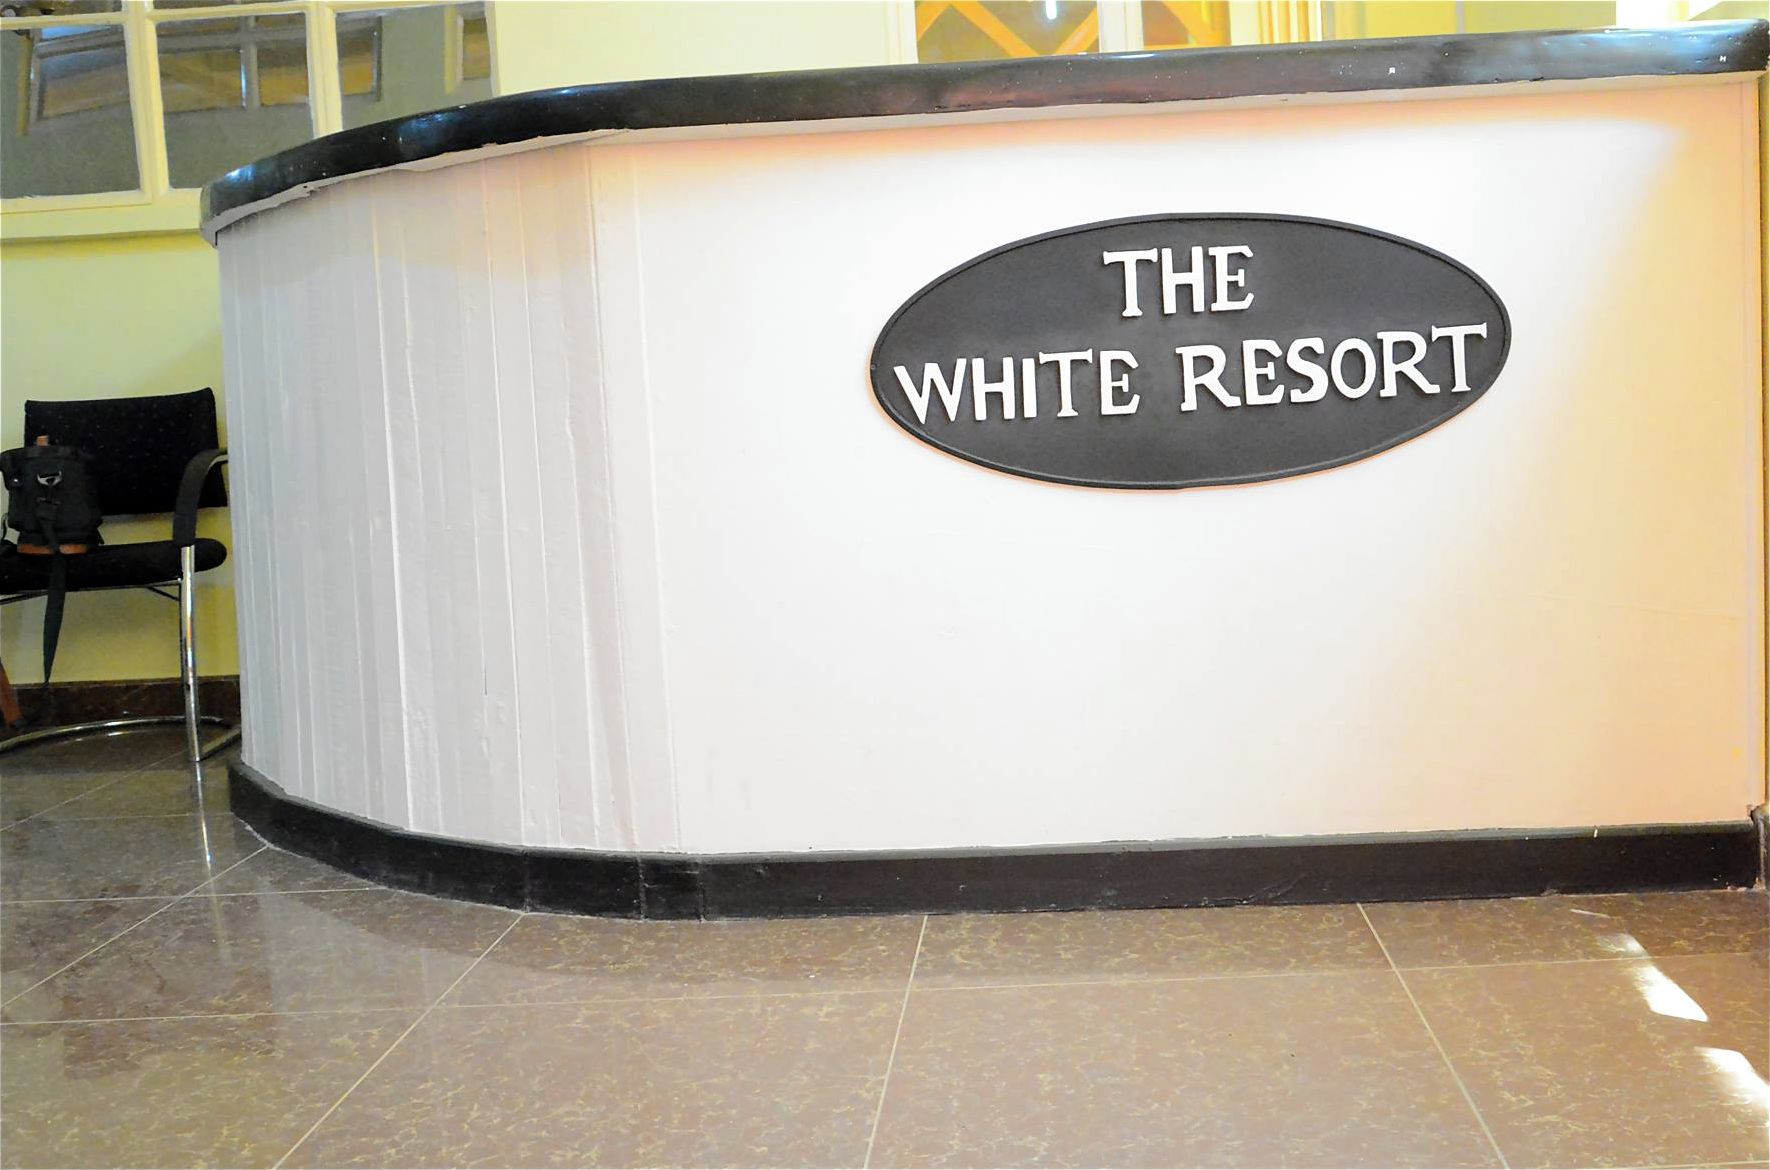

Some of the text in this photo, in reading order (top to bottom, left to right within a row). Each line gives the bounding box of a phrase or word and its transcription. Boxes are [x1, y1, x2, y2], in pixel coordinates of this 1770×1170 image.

[1102, 245, 1256, 317] THE
[893, 322, 1488, 425] WHITE RESORT
